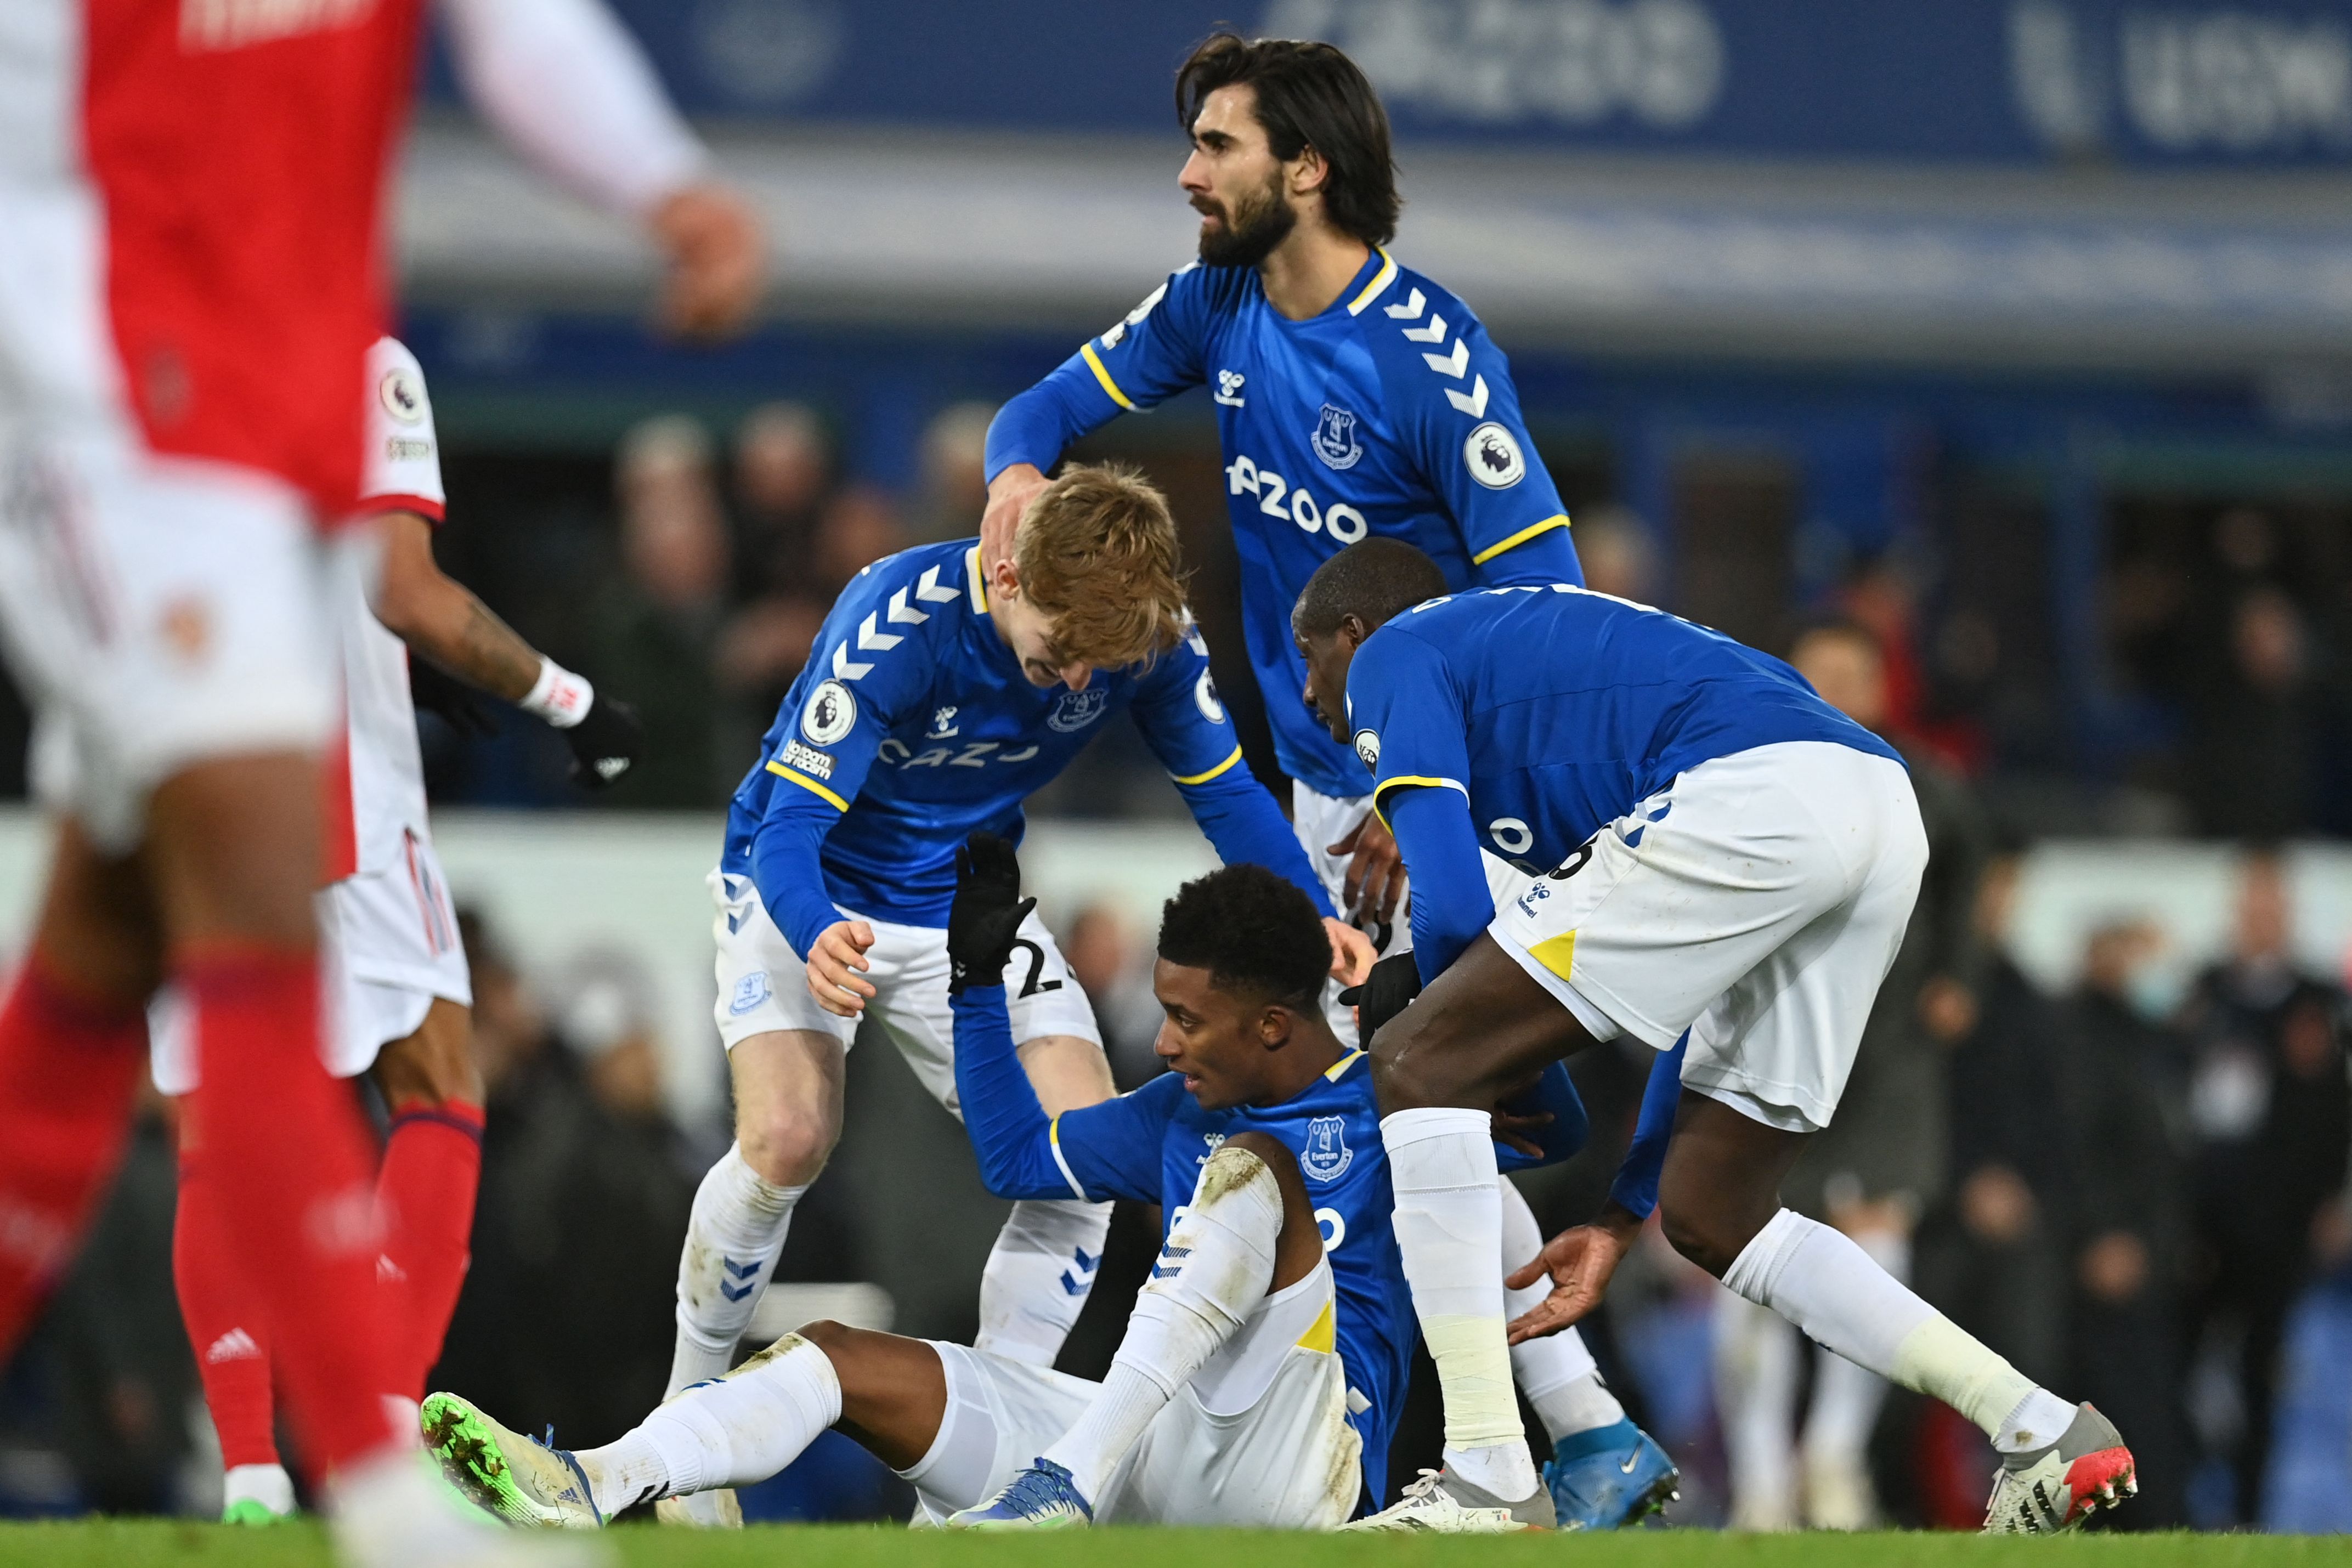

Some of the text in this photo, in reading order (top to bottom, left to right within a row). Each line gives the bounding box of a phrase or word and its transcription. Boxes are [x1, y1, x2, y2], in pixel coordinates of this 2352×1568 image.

[1225, 455, 1368, 545] AZOO
[799, 746, 831, 768] room
[793, 757, 832, 780] racism
[1311, 1152, 1338, 1161] Everton
